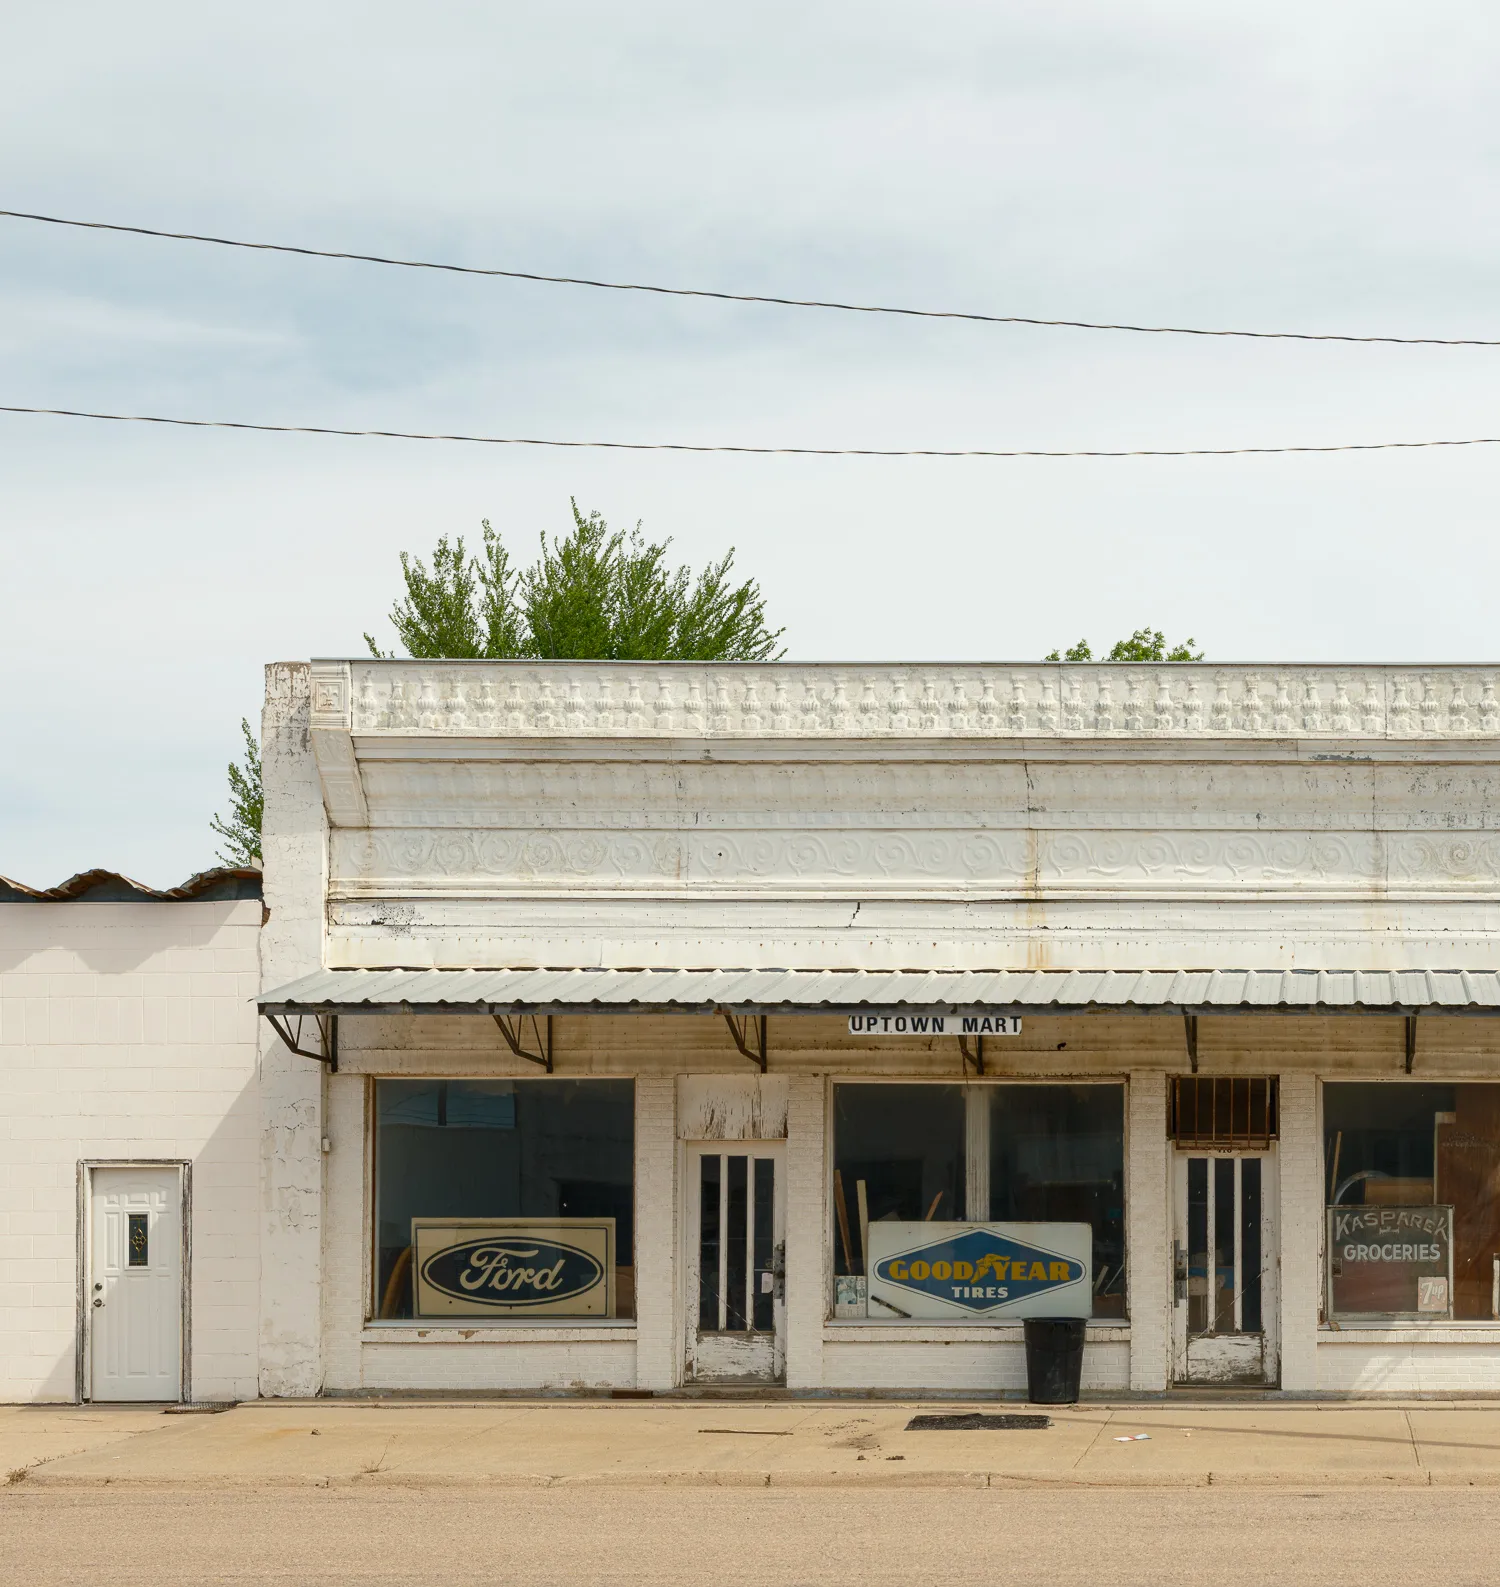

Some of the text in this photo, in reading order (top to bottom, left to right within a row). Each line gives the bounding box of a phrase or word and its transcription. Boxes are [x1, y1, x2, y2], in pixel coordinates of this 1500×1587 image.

[851, 1016, 1022, 1033] UPTOWN MART
[1336, 1211, 1449, 1241] KASPAREK
[1343, 1244, 1441, 1262] GROCERIES
[459, 1247, 566, 1290] Ford
[951, 1286, 1009, 1298] TIRES
